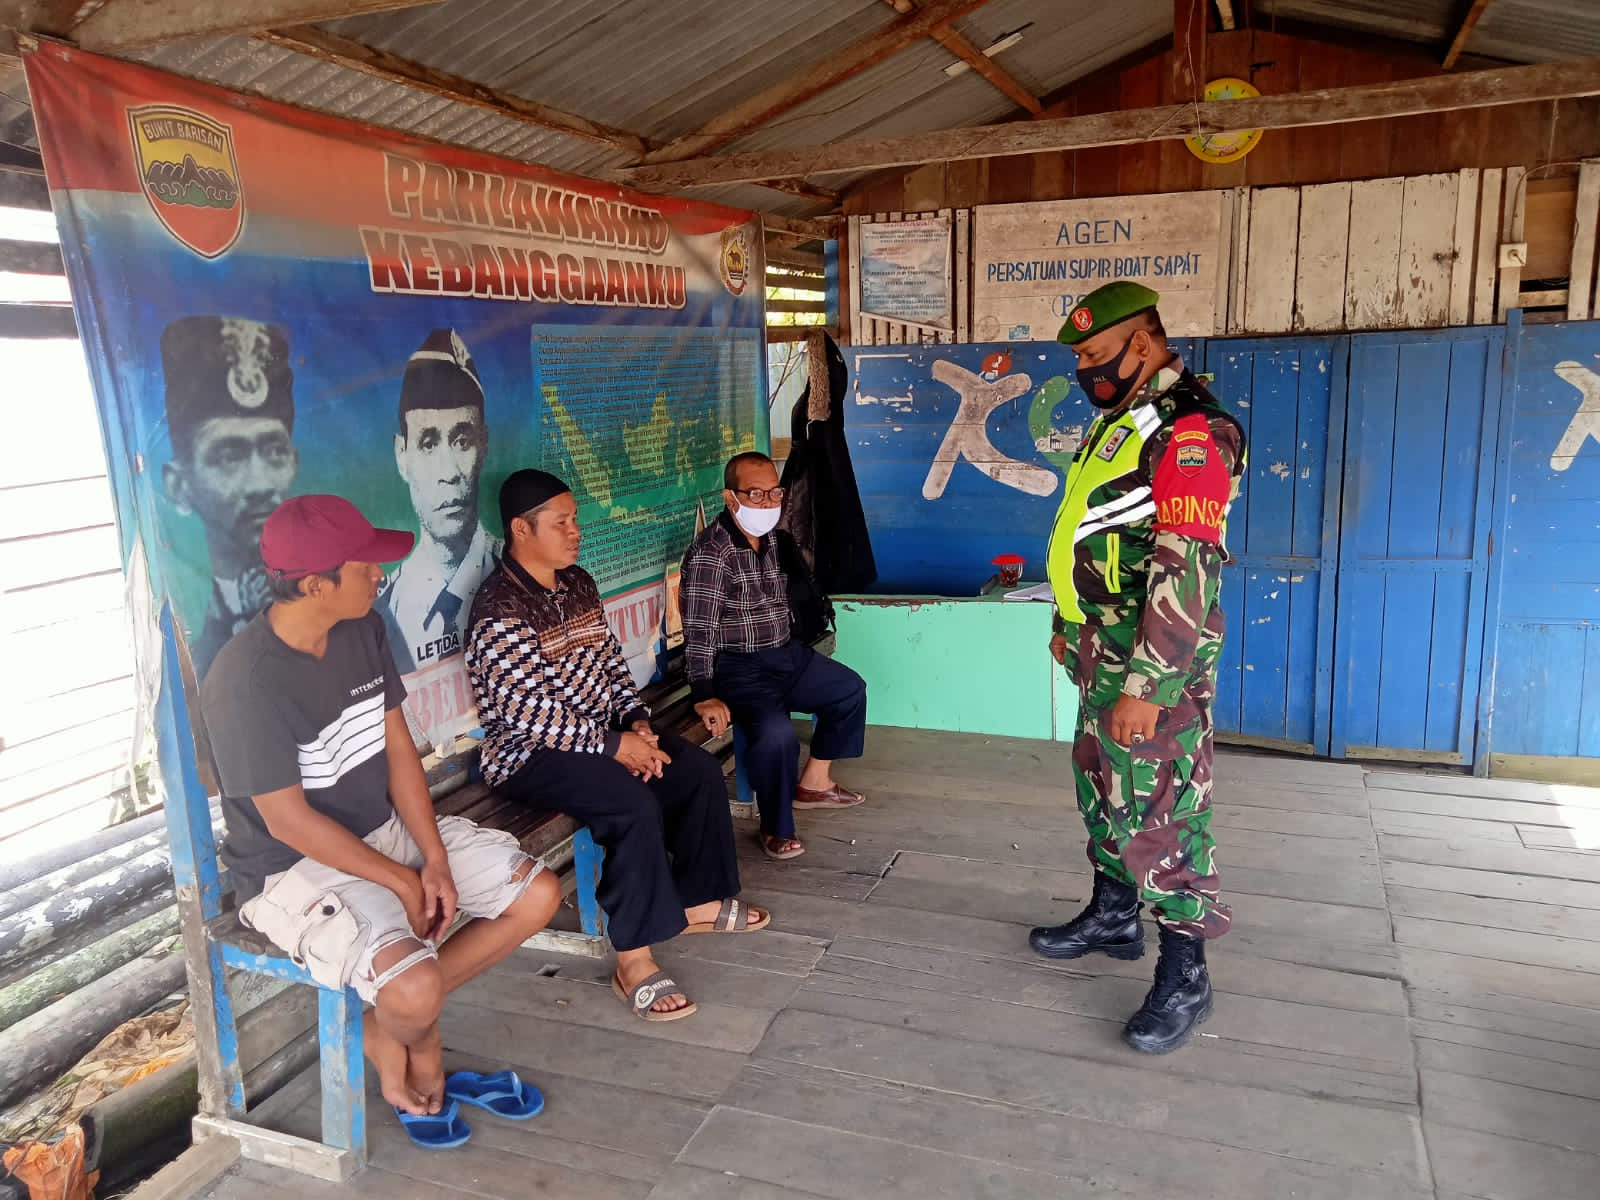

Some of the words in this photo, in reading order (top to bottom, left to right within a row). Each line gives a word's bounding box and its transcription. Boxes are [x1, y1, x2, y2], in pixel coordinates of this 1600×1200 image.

[142, 120, 176, 140] BUKIT
[176, 123, 222, 151] BARISAN
[384, 152, 670, 254] PAHLAWANKU
[1055, 218, 1133, 246] AGEN
[359, 225, 688, 311] KEBANGGAANKU
[987, 260, 1067, 282] PERSATUAN
[1069, 258, 1111, 280] SUPIR
[1113, 256, 1151, 277] BOAT
[1153, 254, 1201, 276] SAPAT
[416, 632, 459, 662] LETDA
